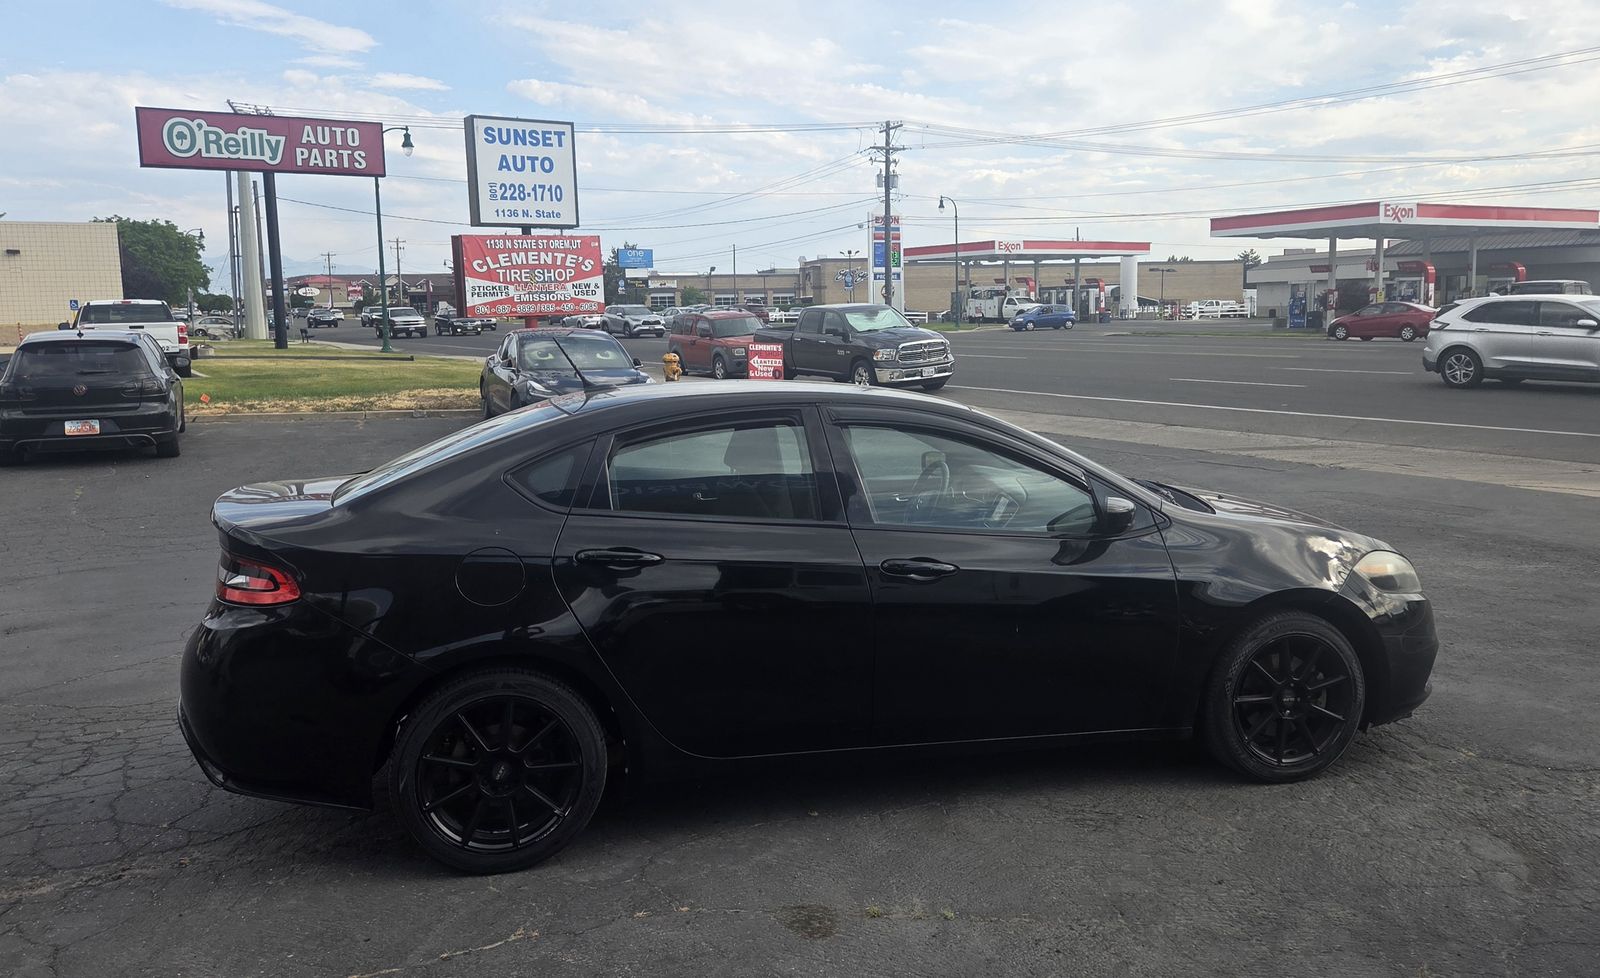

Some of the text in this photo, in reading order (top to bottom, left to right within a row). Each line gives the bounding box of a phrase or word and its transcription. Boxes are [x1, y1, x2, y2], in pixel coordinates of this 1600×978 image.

[164, 118, 285, 164] O'Reilly
[301, 125, 360, 147] AUTO
[483, 126, 566, 148] SUNSET
[296, 147, 366, 169] PARTS
[498, 154, 554, 174] AUTO
[488, 182, 563, 202] (801) 228-1710
[495, 208, 561, 219] 1136 N. State
[1384, 203, 1414, 223] Exxon
[486, 239, 504, 249] 1138
[506, 240, 512, 249] N
[514, 240, 537, 249] STATE
[538, 240, 548, 249] ST
[998, 241, 1021, 253] Exxon
[472, 251, 594, 273] CLEMENTE'S
[496, 268, 575, 282] TIRE SHOP
[514, 283, 567, 292] LLANTERA
[574, 289, 597, 297] USED
[514, 293, 572, 302] EMISSIONS
[749, 343, 782, 352] CLEMENTE'S
